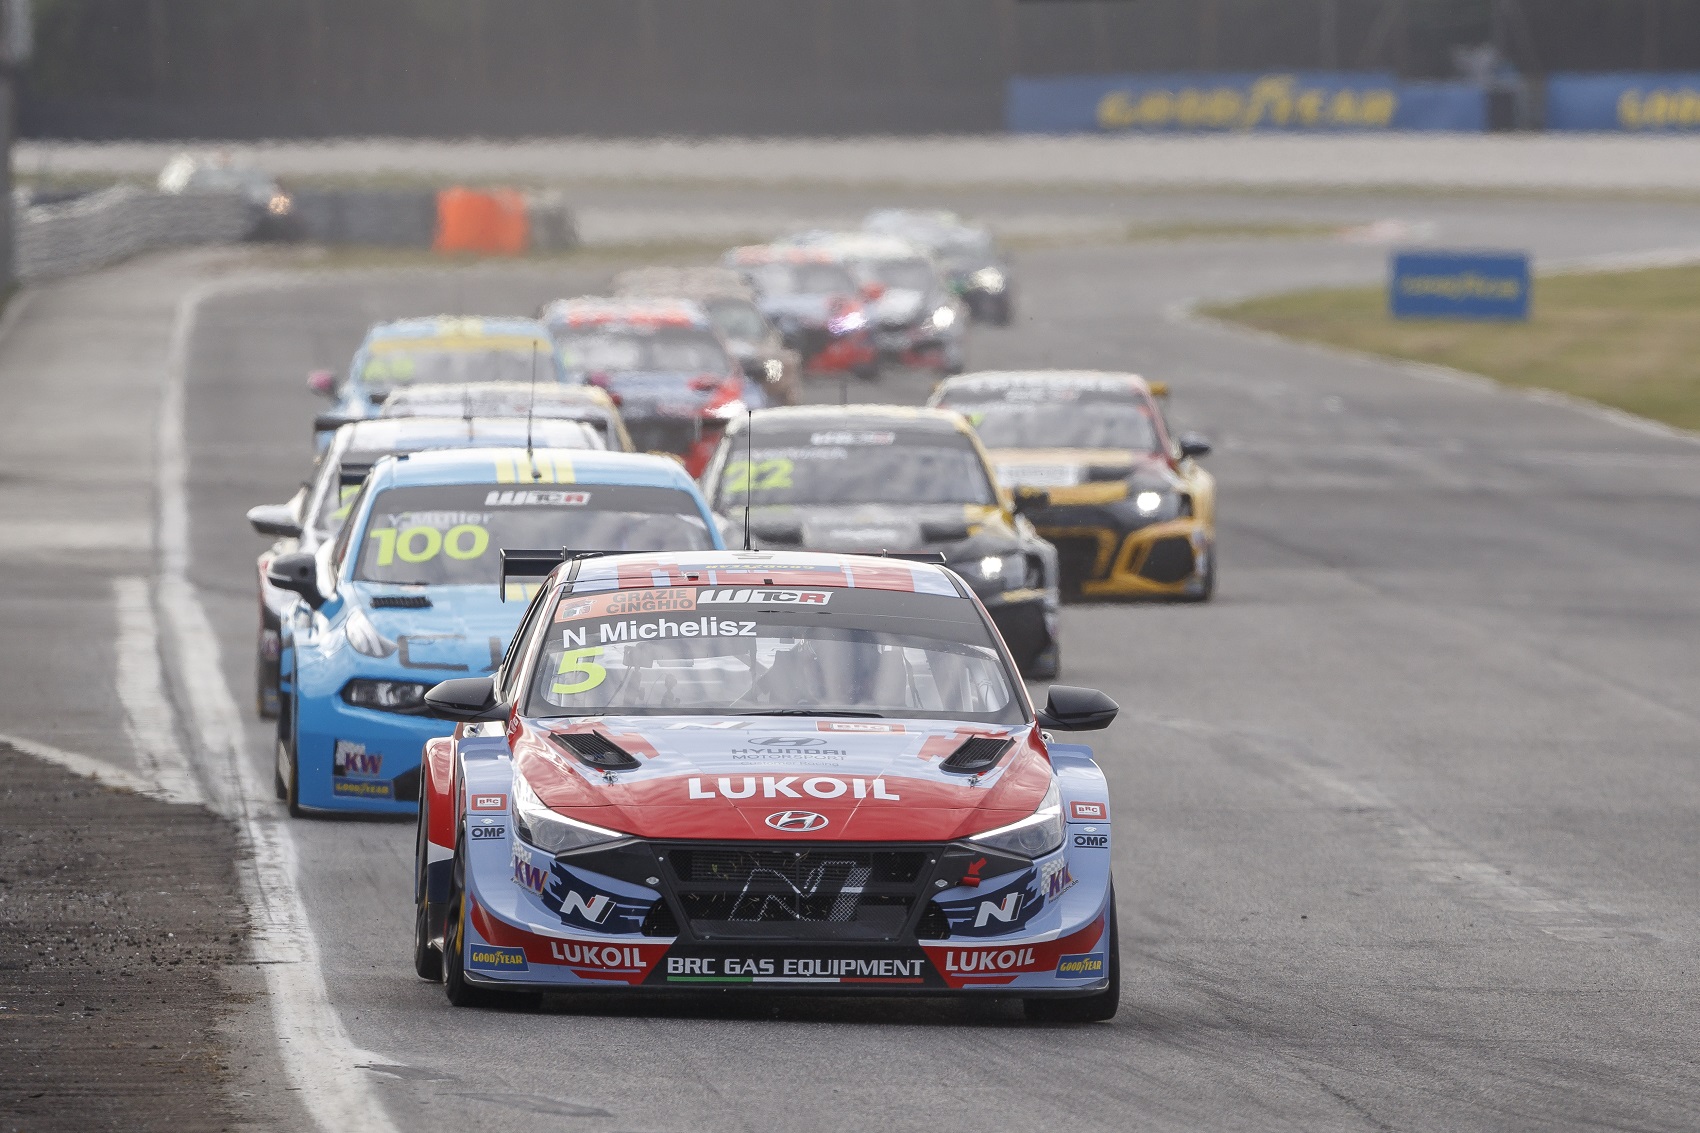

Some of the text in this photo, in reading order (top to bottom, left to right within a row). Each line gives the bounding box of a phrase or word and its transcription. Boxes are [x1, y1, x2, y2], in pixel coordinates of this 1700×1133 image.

[724, 459, 794, 493] 22
[370, 524, 490, 567] 100
[606, 599, 694, 614] CINGHIO
[612, 590, 688, 603] GRAZIE
[697, 589, 834, 604] WTCR
[563, 616, 757, 649] N Michelisz
[552, 646, 607, 694] 5
[688, 776, 900, 801] LUKOIL
[471, 827, 505, 837] OMP
[1074, 836, 1108, 846] OMP
[515, 854, 549, 893] KW
[472, 949, 523, 966] GOODYEAR
[550, 941, 647, 967] LUKOIL
[945, 947, 1036, 971] LUKOIL
[667, 957, 925, 976] BRC GAS EQUIPMENT
[1059, 957, 1102, 974] GOODYEAR
